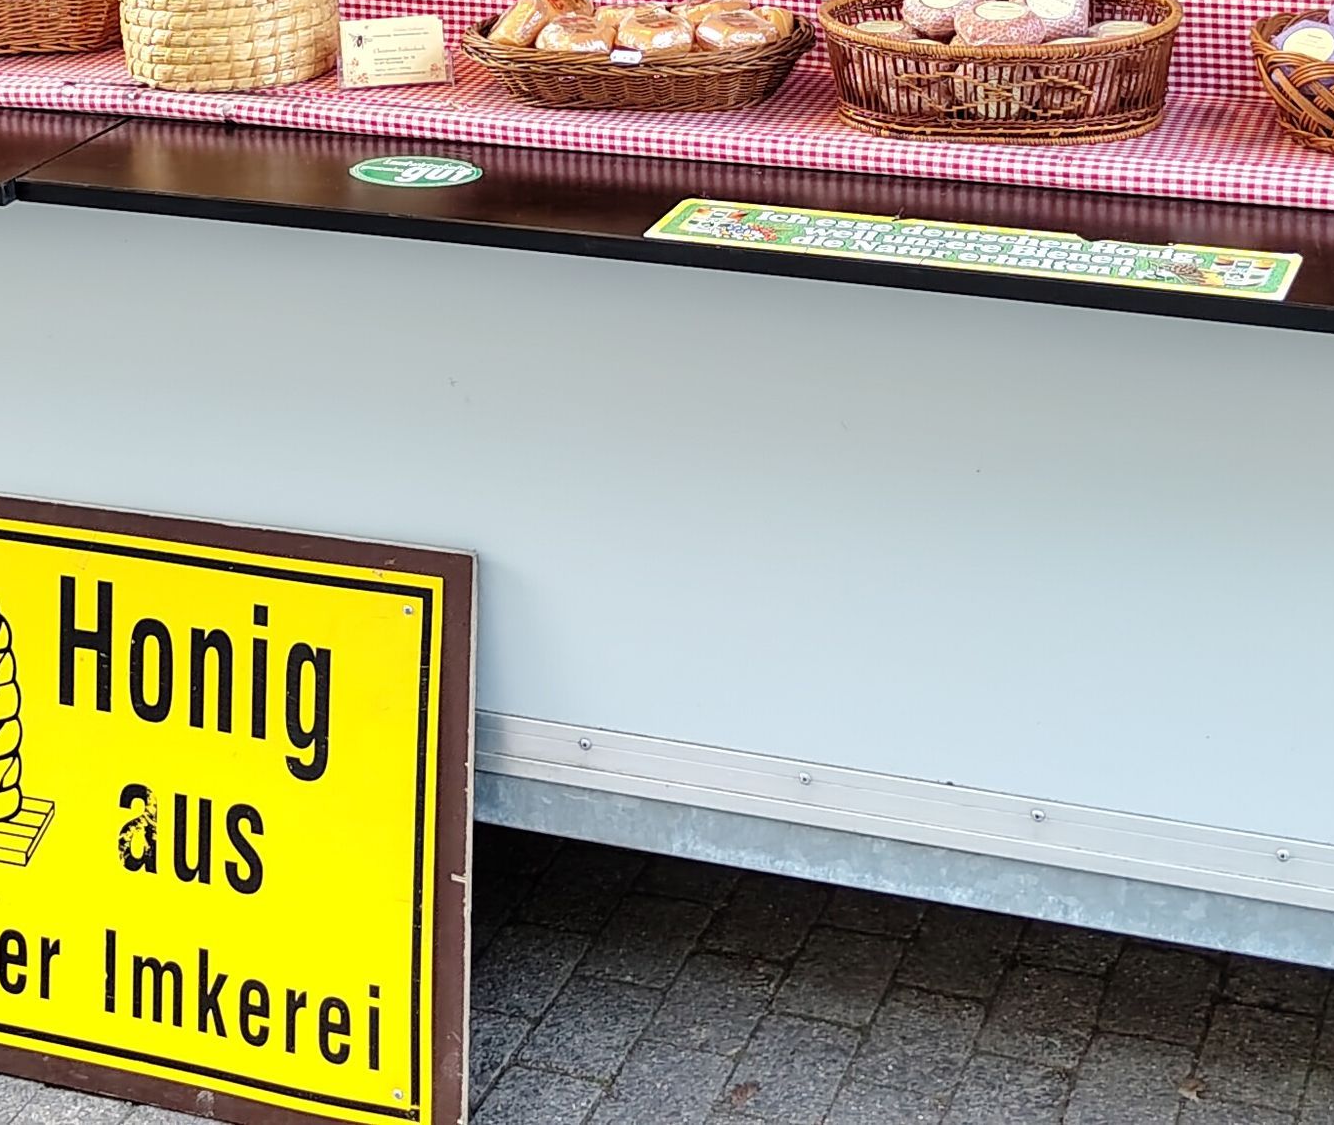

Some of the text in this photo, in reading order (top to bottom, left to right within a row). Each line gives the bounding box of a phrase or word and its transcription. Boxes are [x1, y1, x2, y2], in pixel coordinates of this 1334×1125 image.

[756, 211, 812, 225] Ich
[816, 217, 895, 232] esse
[901, 225, 1083, 251] deutschen
[790, 235, 845, 249] die
[848, 239, 955, 260] Natur
[805, 227, 1136, 266] weil unsere Bienen
[59, 574, 333, 782] Honig
[118, 782, 265, 895] aus
[104, 928, 382, 1073] Imkerei
